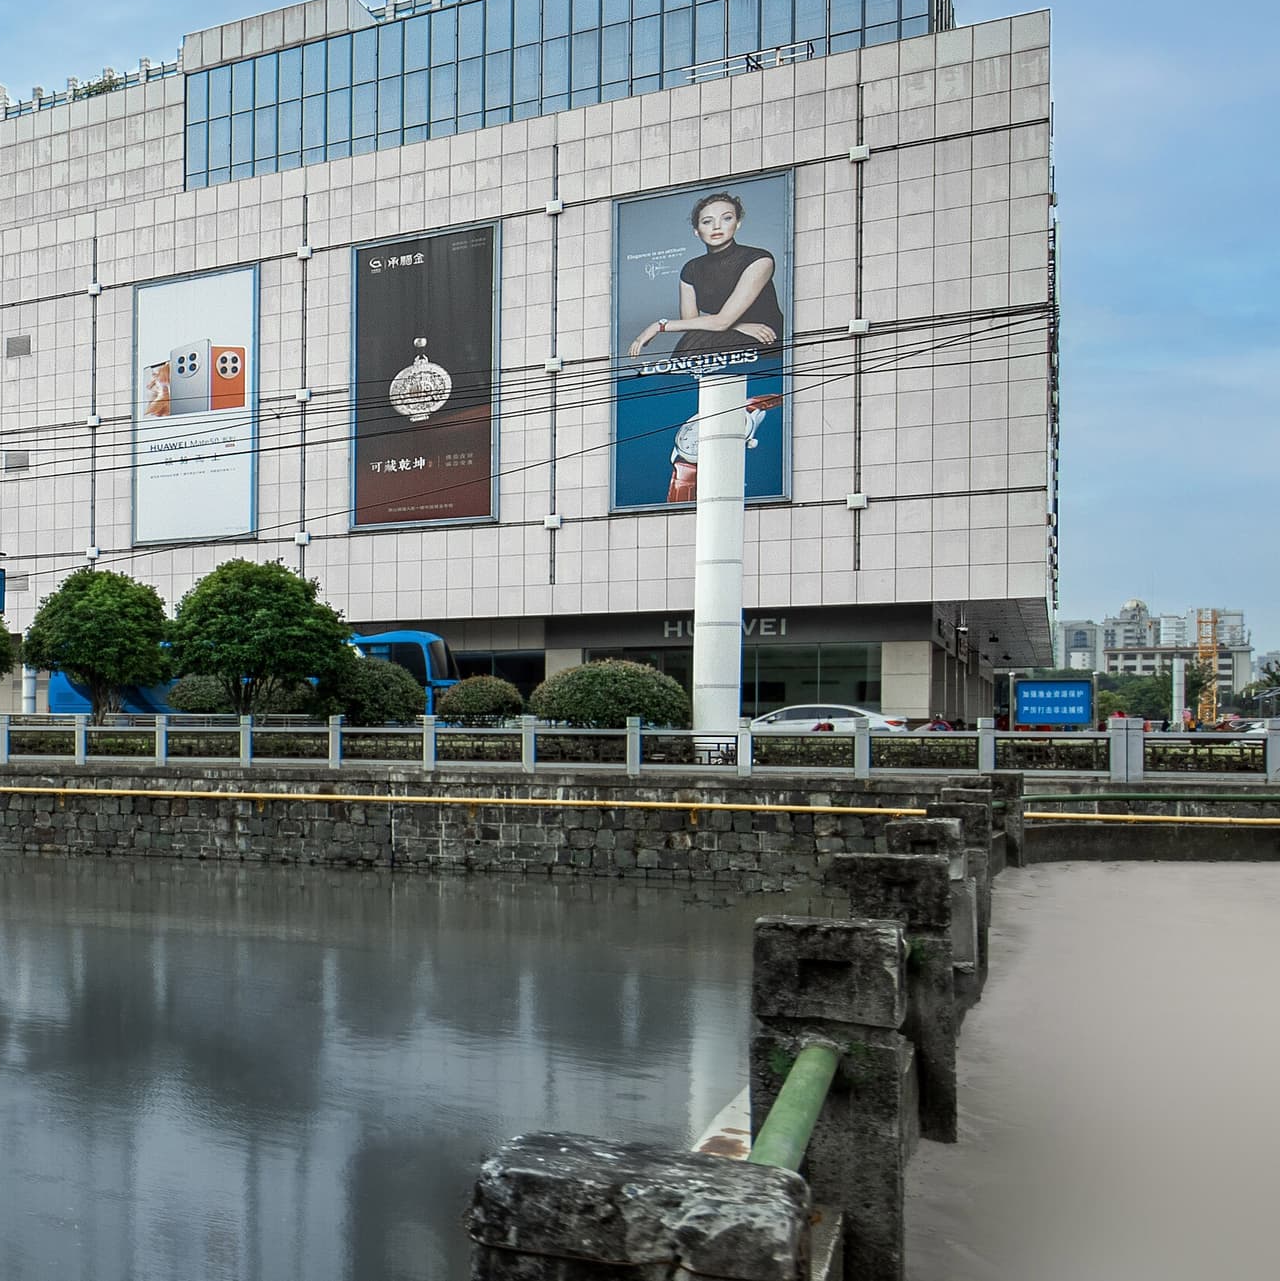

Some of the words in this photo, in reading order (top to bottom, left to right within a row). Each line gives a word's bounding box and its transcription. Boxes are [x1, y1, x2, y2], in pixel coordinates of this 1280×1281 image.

[640, 348, 759, 374] LONGINES
[150, 440, 188, 452] HUAWEI
[369, 456, 426, 473] 可藏乾坤
